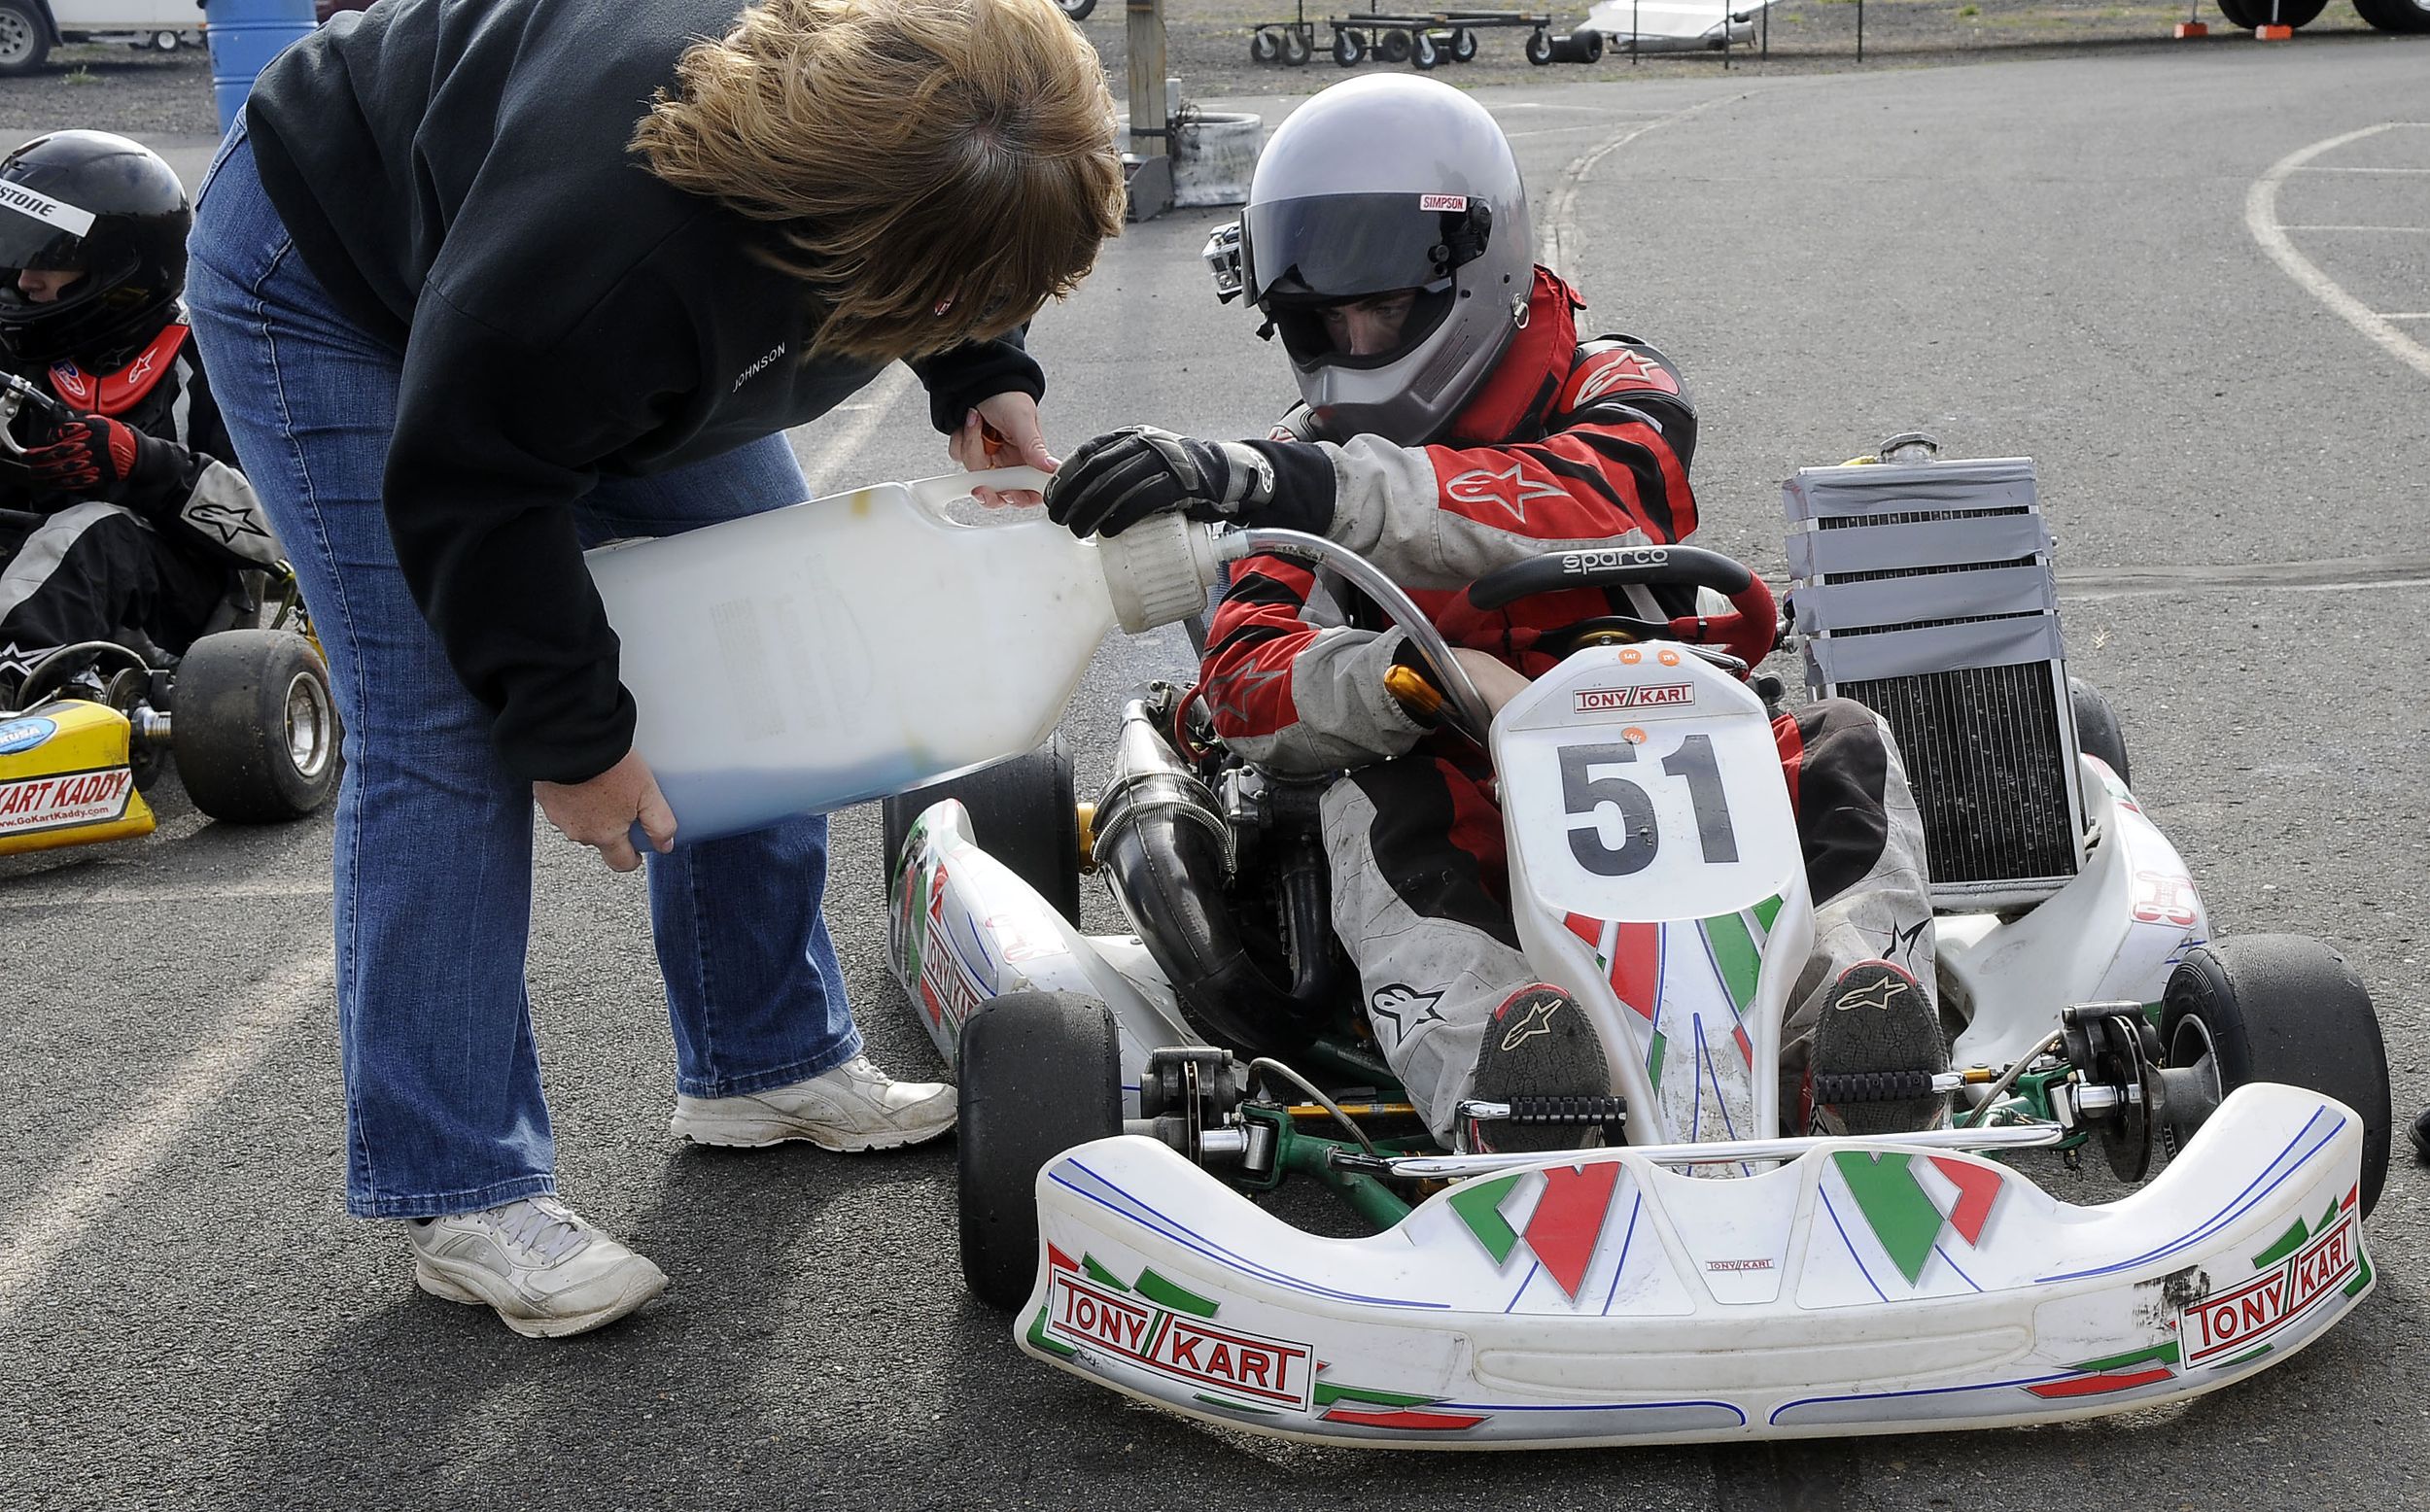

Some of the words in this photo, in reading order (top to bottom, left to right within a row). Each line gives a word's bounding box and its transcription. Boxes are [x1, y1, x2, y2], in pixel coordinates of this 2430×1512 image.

[1423, 196, 1464, 210] SIMPSON
[732, 341, 785, 393] JOHNSON
[1561, 548, 1669, 575] sparco
[1576, 689, 1627, 707] TONY
[1640, 684, 1692, 704] KART
[0, 781, 54, 815] ART
[51, 771, 130, 809] KADDY
[1557, 734, 1740, 876] 51
[926, 921, 951, 993] TONY
[1708, 1260, 1736, 1270] TONY
[1743, 1258, 1772, 1269] KART
[2184, 1269, 2284, 1347] TONY
[2300, 1217, 2352, 1300] KART
[1058, 1277, 1149, 1350] TONY
[1172, 1321, 1306, 1391] KART
